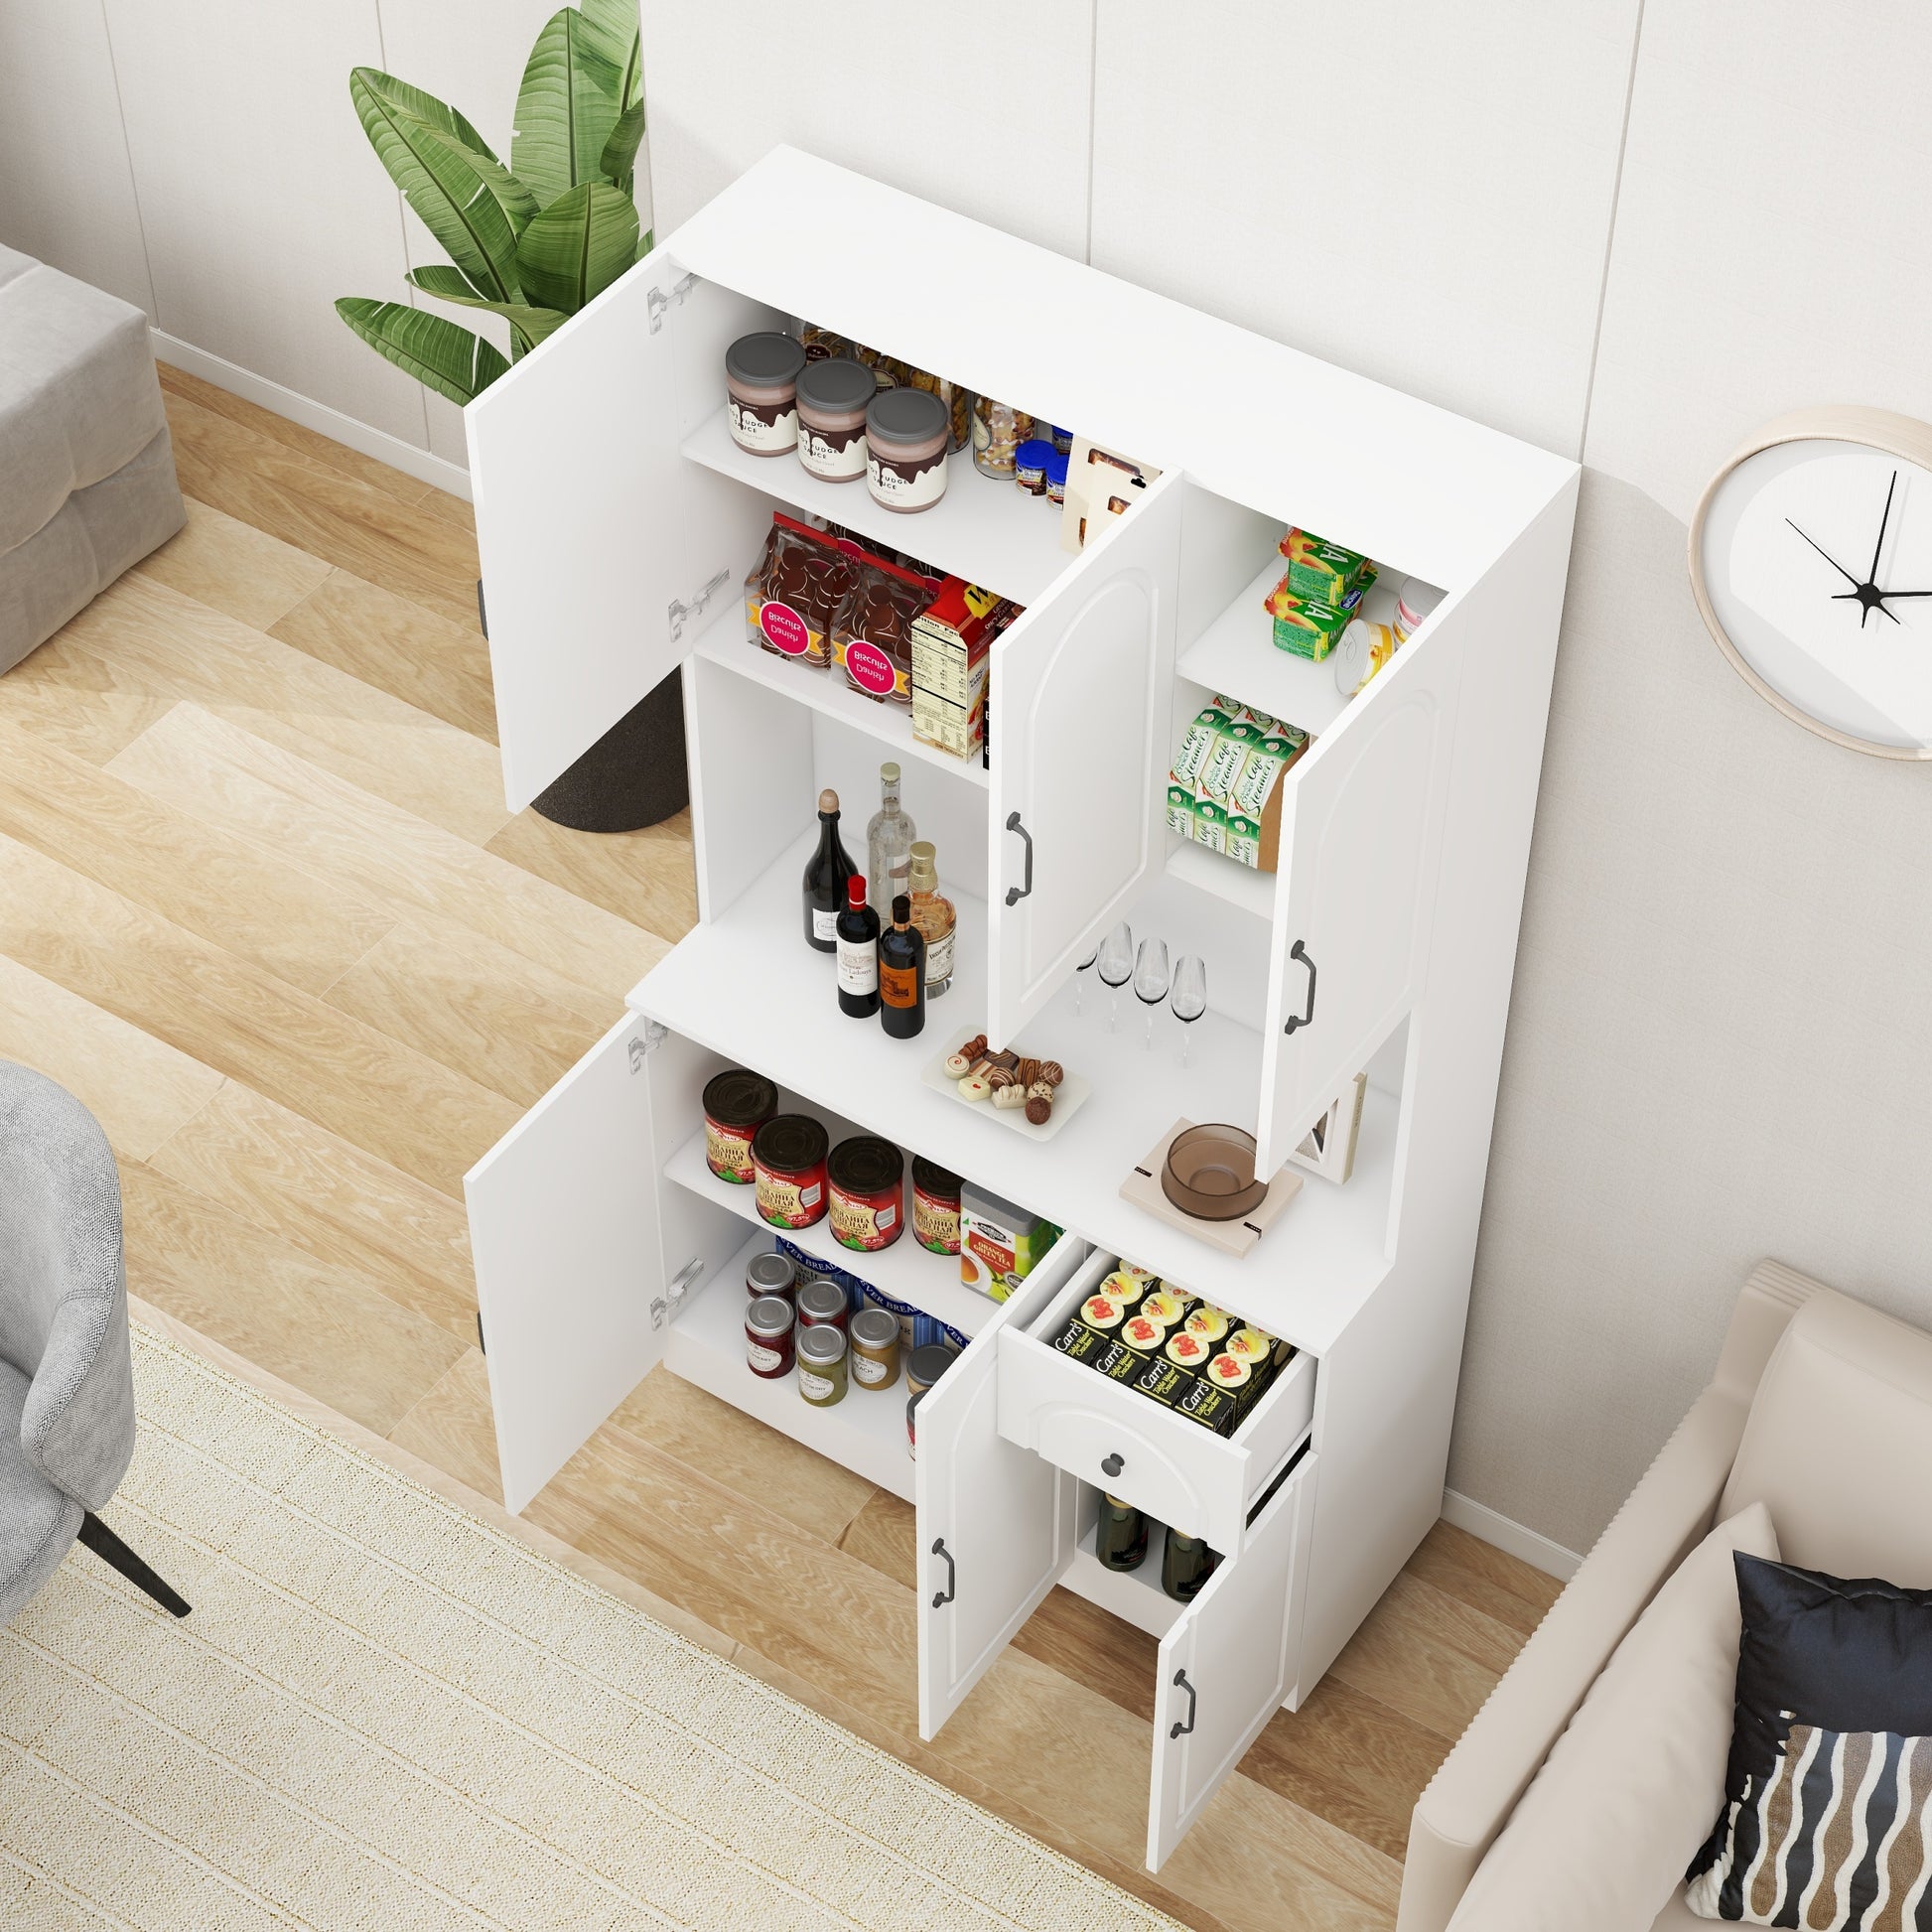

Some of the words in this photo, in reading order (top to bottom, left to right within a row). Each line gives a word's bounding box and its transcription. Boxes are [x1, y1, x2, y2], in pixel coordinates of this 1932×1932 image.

[944, 627, 960, 636] Fac
[1181, 730, 1209, 788] Steamers
[1213, 745, 1242, 802] Steamers
[1245, 759, 1275, 817] Steamers
[973, 1244, 998, 1261] GREEN
[998, 1256, 1011, 1268] TEA
[978, 1241, 1005, 1259] ORANGE
[805, 1259, 837, 1272] BREAD
[1055, 1322, 1083, 1351] Carr's
[1066, 1343, 1080, 1356] Table
[1096, 1343, 1124, 1373] Carr's
[1108, 1364, 1121, 1378] Table
[1140, 1360, 1168, 1390] Carr's
[1152, 1380, 1165, 1394] Table
[1181, 1381, 1209, 1411] Carr's
[1193, 1403, 1207, 1417] Table
